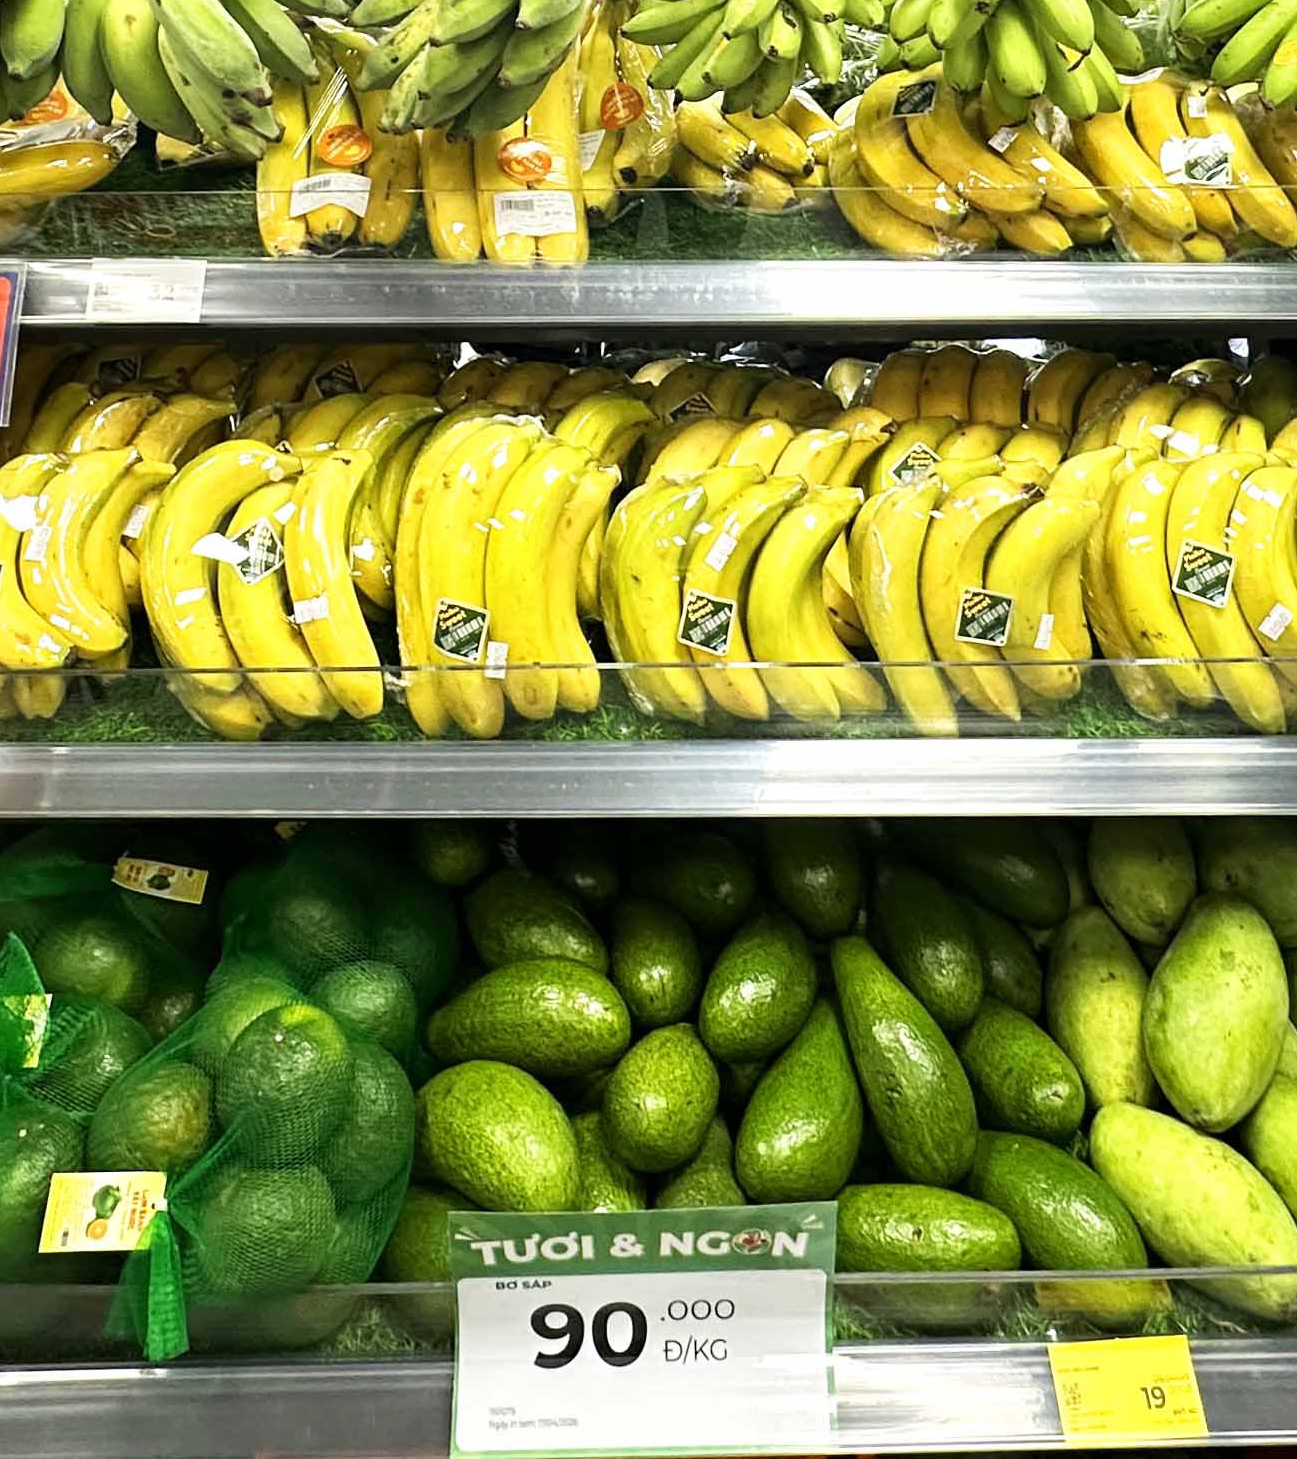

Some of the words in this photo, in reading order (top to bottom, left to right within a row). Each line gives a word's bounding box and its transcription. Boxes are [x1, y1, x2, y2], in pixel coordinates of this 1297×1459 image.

[470, 1231, 594, 1266] TƯƠI
[610, 1233, 644, 1257] &
[496, 1281, 518, 1290] BƠ
[522, 1279, 552, 1289] SÁP
[530, 1301, 648, 1369] 90
[663, 1334, 728, 1365] Đ/KG
[1140, 1387, 1167, 1410] 19
